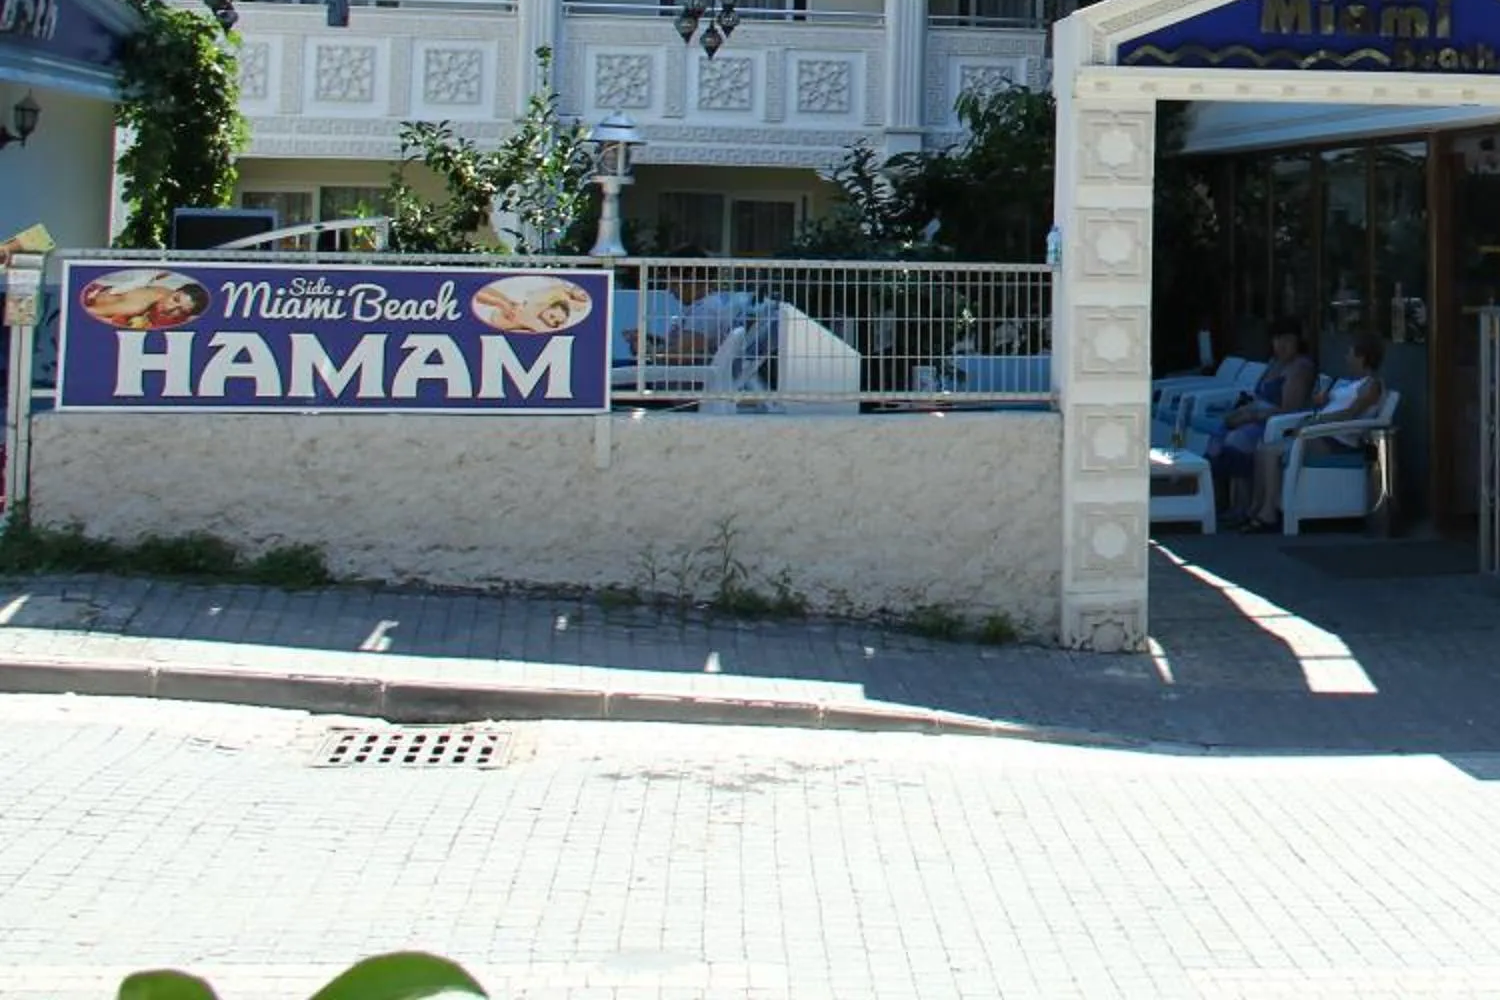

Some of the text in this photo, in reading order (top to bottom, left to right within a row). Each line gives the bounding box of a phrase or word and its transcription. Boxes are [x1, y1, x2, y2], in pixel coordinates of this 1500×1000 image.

[221, 280, 462, 323] Miami Beach
[289, 277, 334, 297] Side
[113, 330, 574, 399] HAMAM
